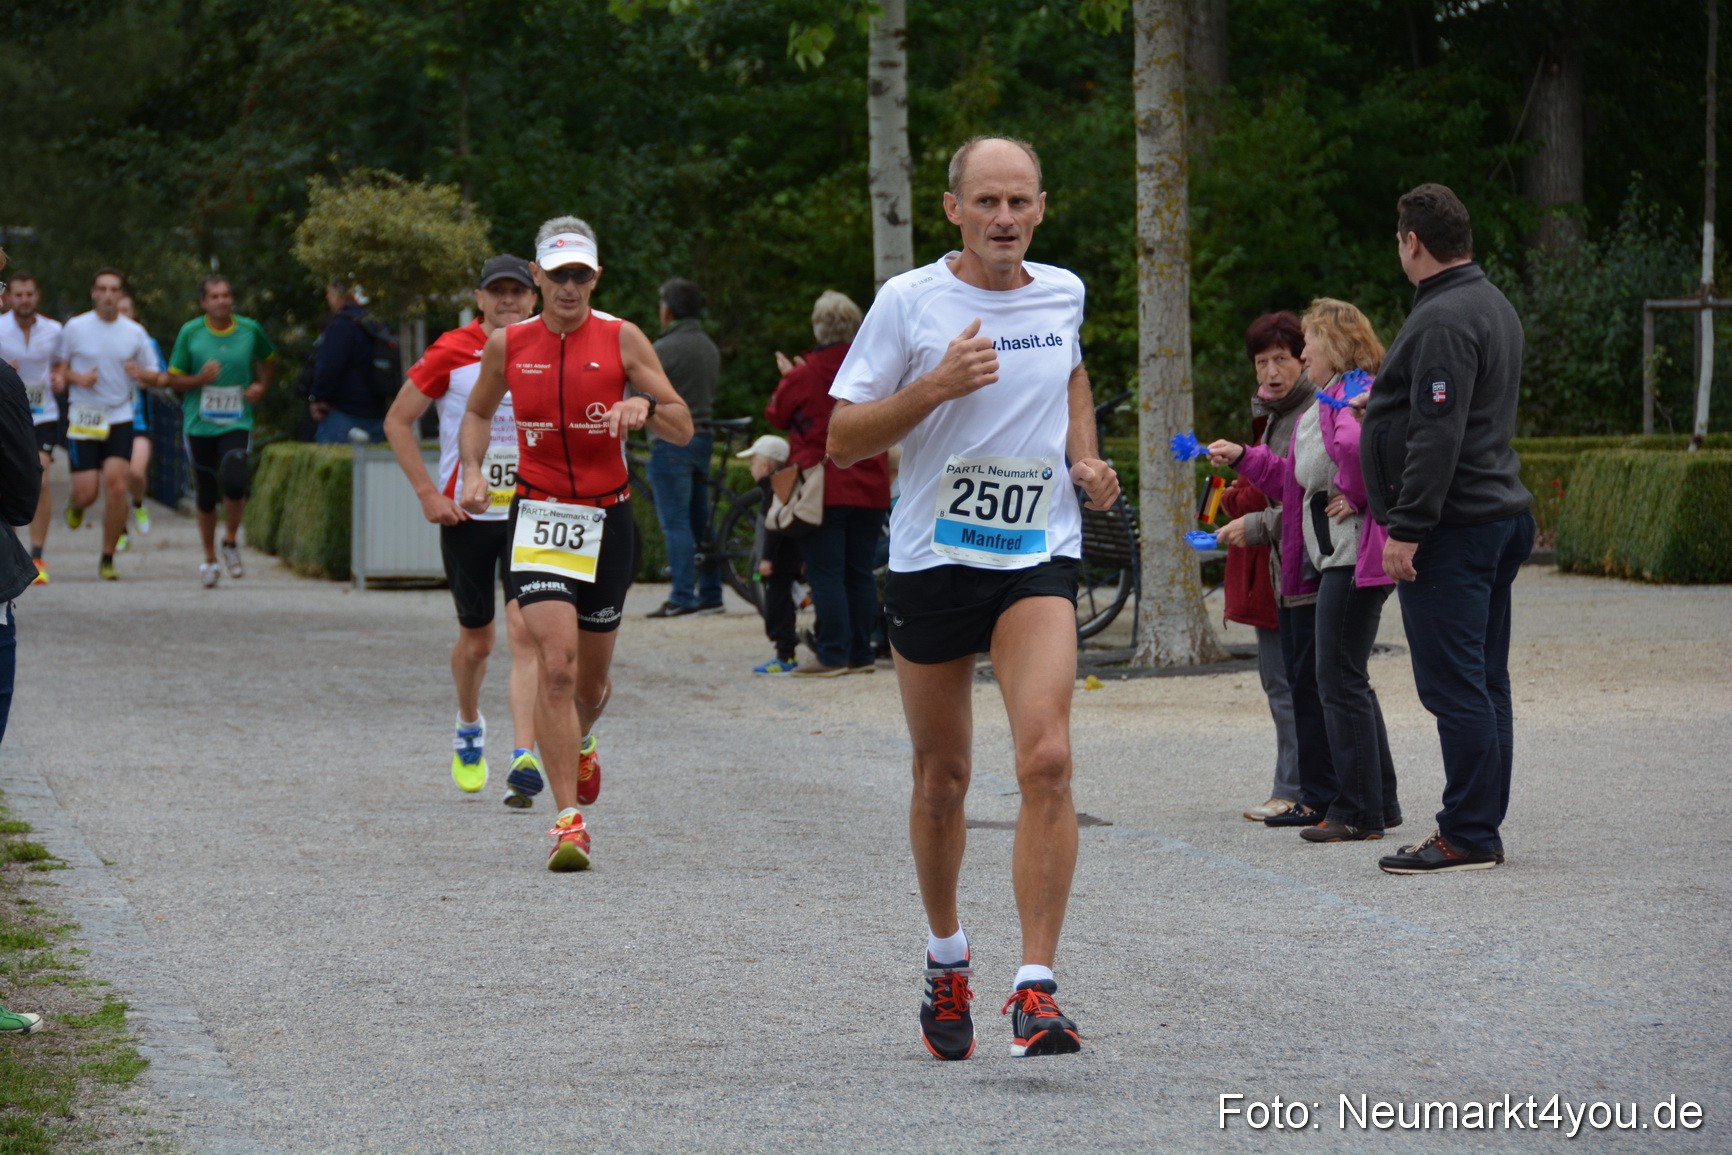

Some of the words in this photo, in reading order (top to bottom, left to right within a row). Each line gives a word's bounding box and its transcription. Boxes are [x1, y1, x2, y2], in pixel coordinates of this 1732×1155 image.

[946, 464, 985, 474] PARTL
[988, 465, 1038, 479] Neumarkt
[948, 477, 1044, 524] 2507
[521, 506, 549, 516] PARTL
[550, 510, 589, 521] Neumarkt
[533, 520, 586, 550] 503
[961, 528, 1023, 550] Manfred
